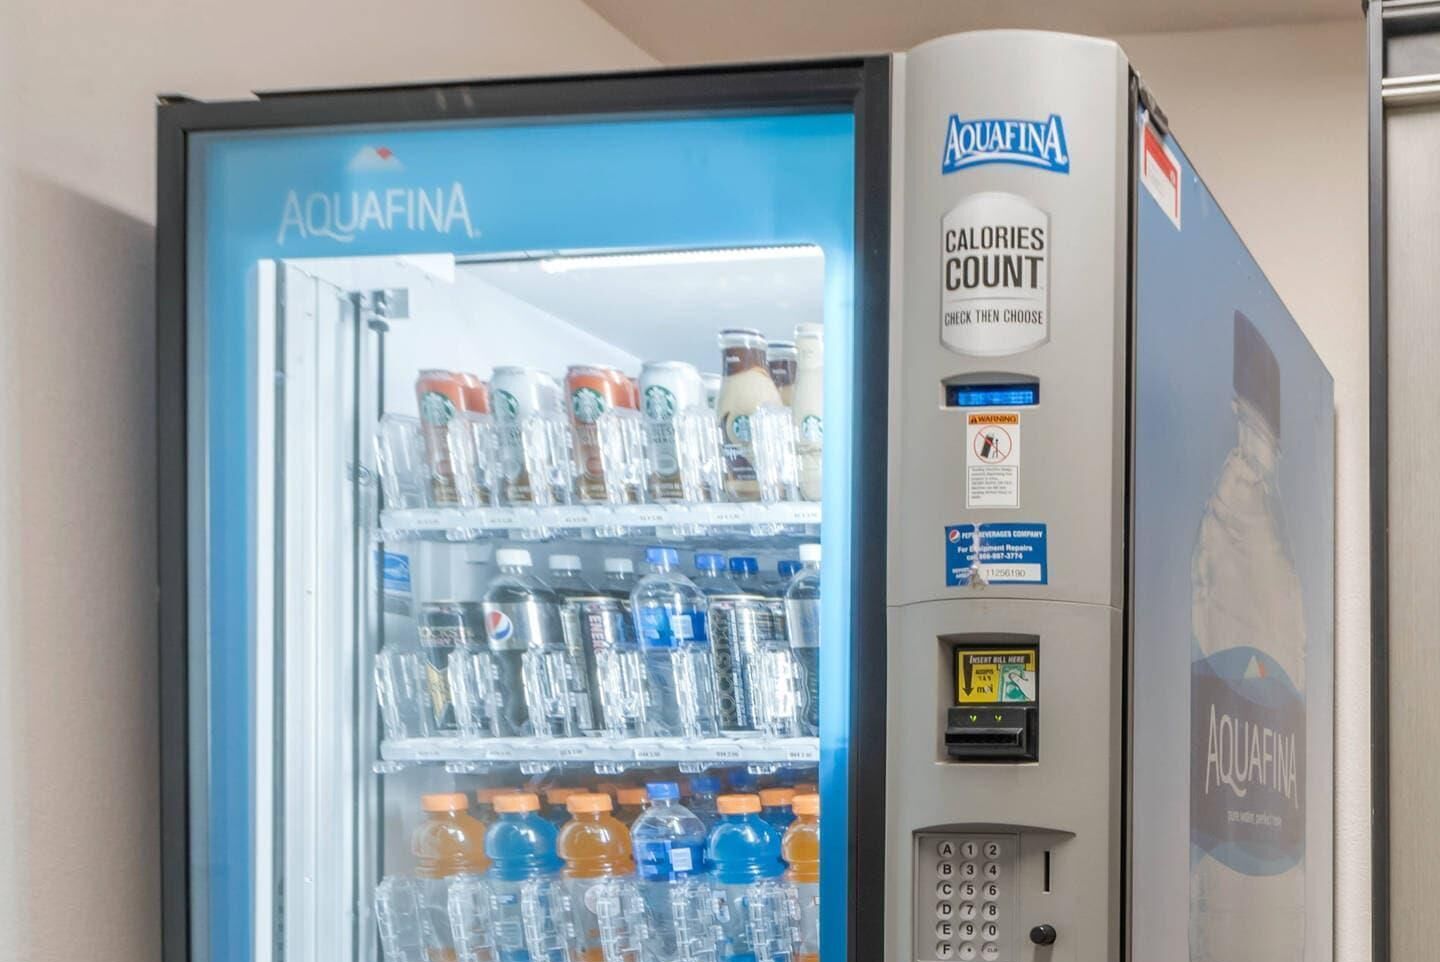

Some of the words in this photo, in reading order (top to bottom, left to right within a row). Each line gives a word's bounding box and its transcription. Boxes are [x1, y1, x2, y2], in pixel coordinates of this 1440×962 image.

[943, 117, 1068, 166] AQUAFINA
[277, 181, 475, 247] AQUAFINA
[945, 226, 1044, 253] CALORIES
[945, 255, 1044, 291] COUNT
[944, 310, 971, 327] CHECK
[976, 309, 999, 323] THEN
[1003, 309, 1043, 324] CHOOSE
[978, 415, 1017, 423] WARNING
[1012, 530, 1043, 538] COMPANY
[1006, 544, 1033, 553] Repairs
[969, 656, 992, 665] INSERT
[1008, 655, 1025, 664] HERE
[1205, 703, 1299, 809] AQUAFINA
[942, 844, 953, 855] A
[967, 844, 973, 855] 1
[990, 844, 997, 855] 2
[943, 864, 952, 875] B
[966, 864, 974, 875] 3
[989, 864, 997, 875] 4
[942, 884, 952, 895] C
[966, 884, 974, 895] 5
[989, 884, 997, 895] 6
[942, 904, 952, 915] D
[966, 904, 974, 915] 7
[989, 904, 996, 915] 8
[943, 924, 951, 935] E
[966, 924, 974, 935] 9
[989, 924, 996, 936] 0
[943, 944, 951, 955] F
